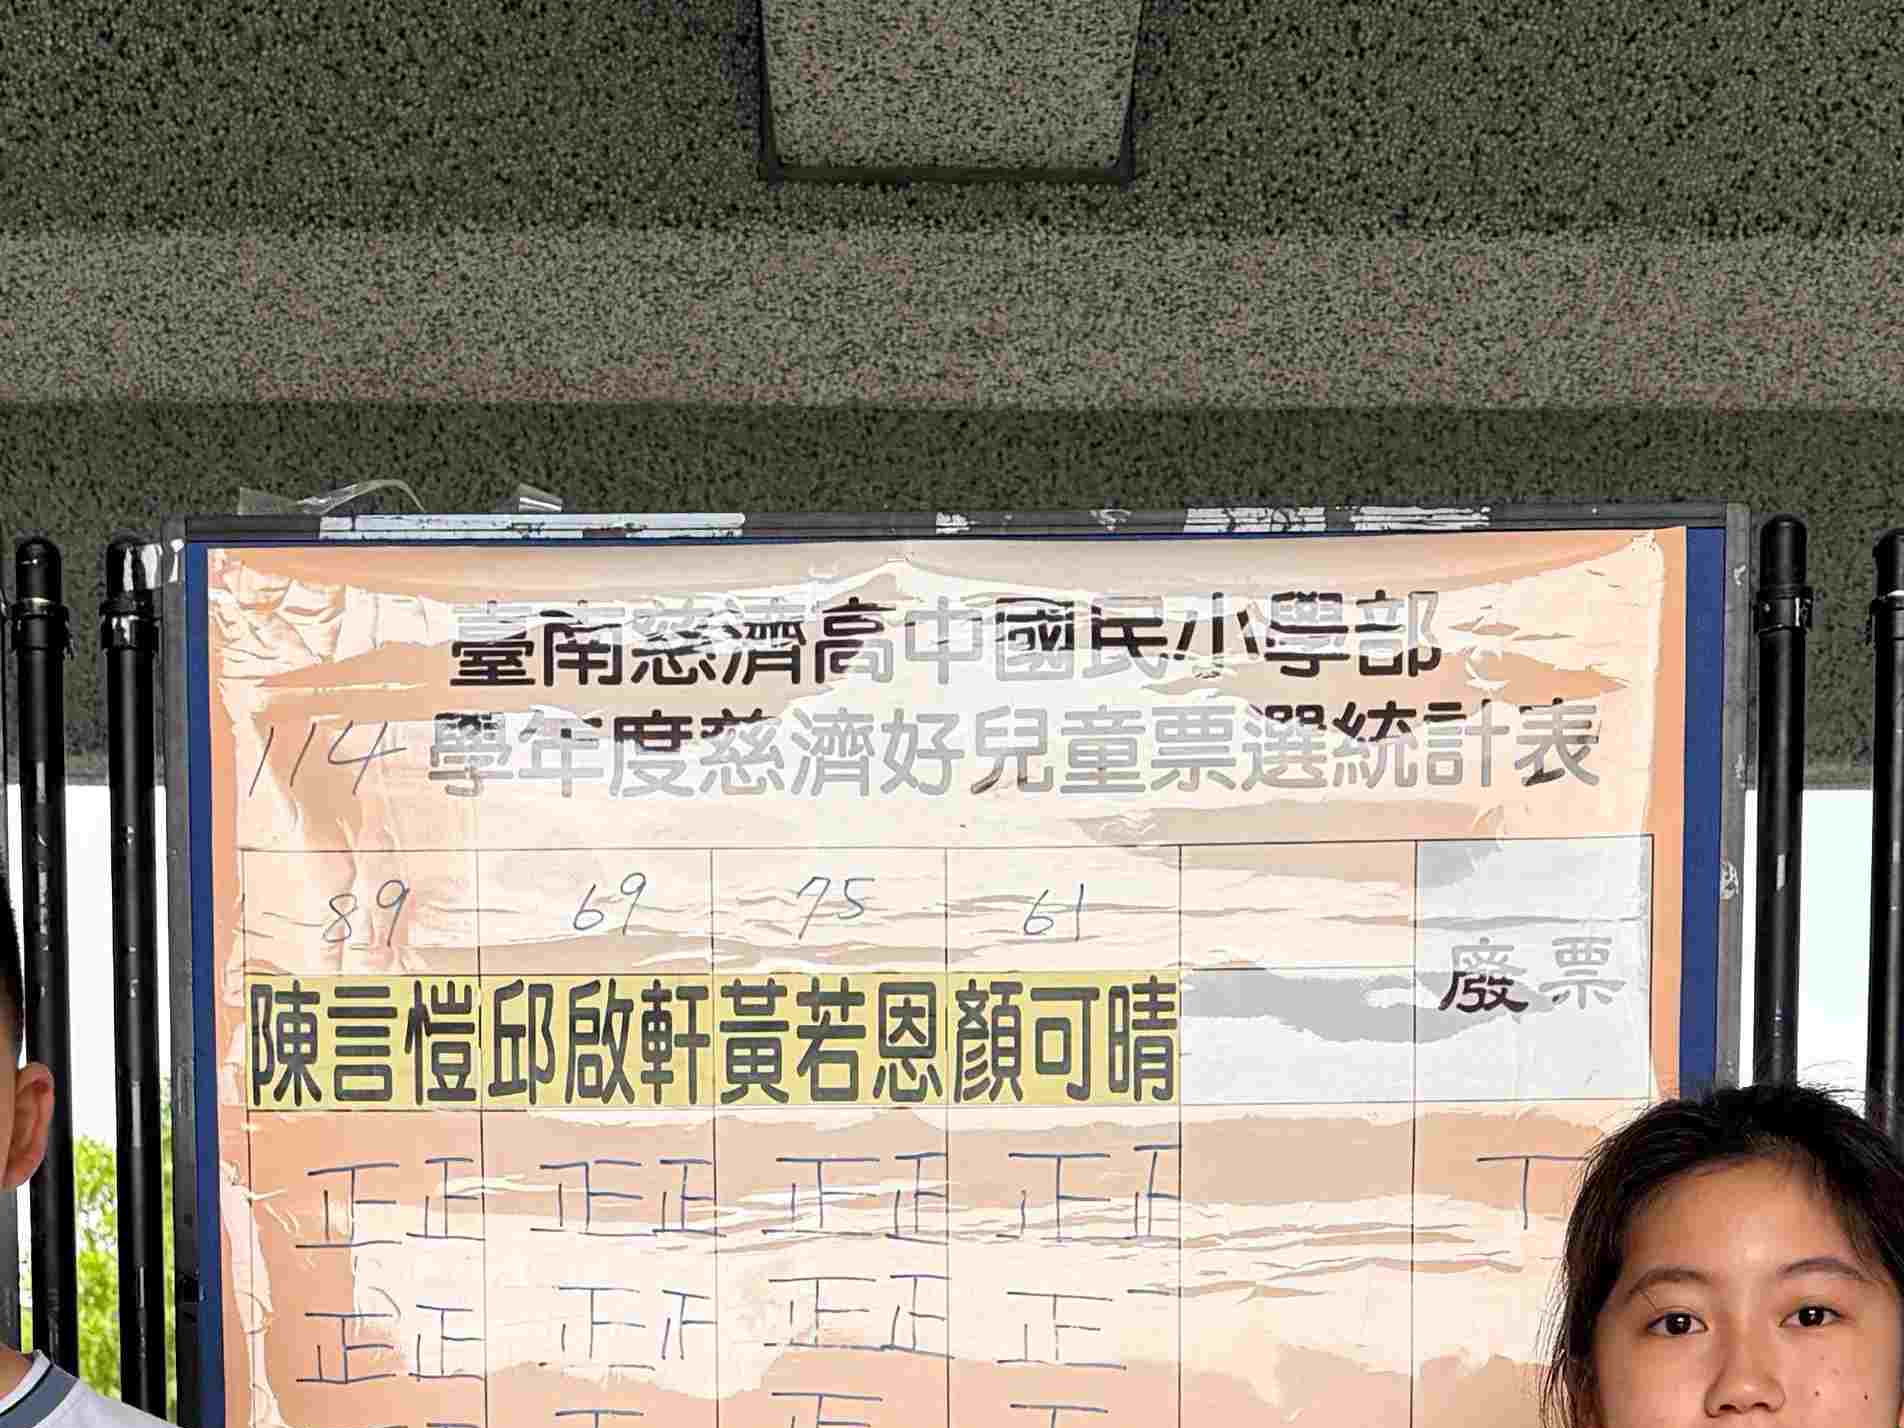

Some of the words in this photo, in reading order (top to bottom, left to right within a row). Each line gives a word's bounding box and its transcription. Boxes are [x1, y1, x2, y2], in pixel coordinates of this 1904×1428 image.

[450, 590, 1441, 686] 臺南慈濟高中國民小學部
[248, 718, 408, 798] 114
[428, 698, 1600, 797] 學年度慈濟好兒童票選統計表
[323, 879, 411, 950] 89
[571, 871, 647, 933] 69
[796, 873, 875, 929] 75
[1022, 883, 1086, 943] 61
[1438, 934, 1628, 1014] 廢票
[250, 979, 477, 1106] 陳言愷
[488, 979, 711, 1104] 邱啟軒
[719, 977, 943, 1104] 黃若恩
[954, 975, 1178, 1102] 顏可晴
[997, 1291, 1127, 1370] 正
